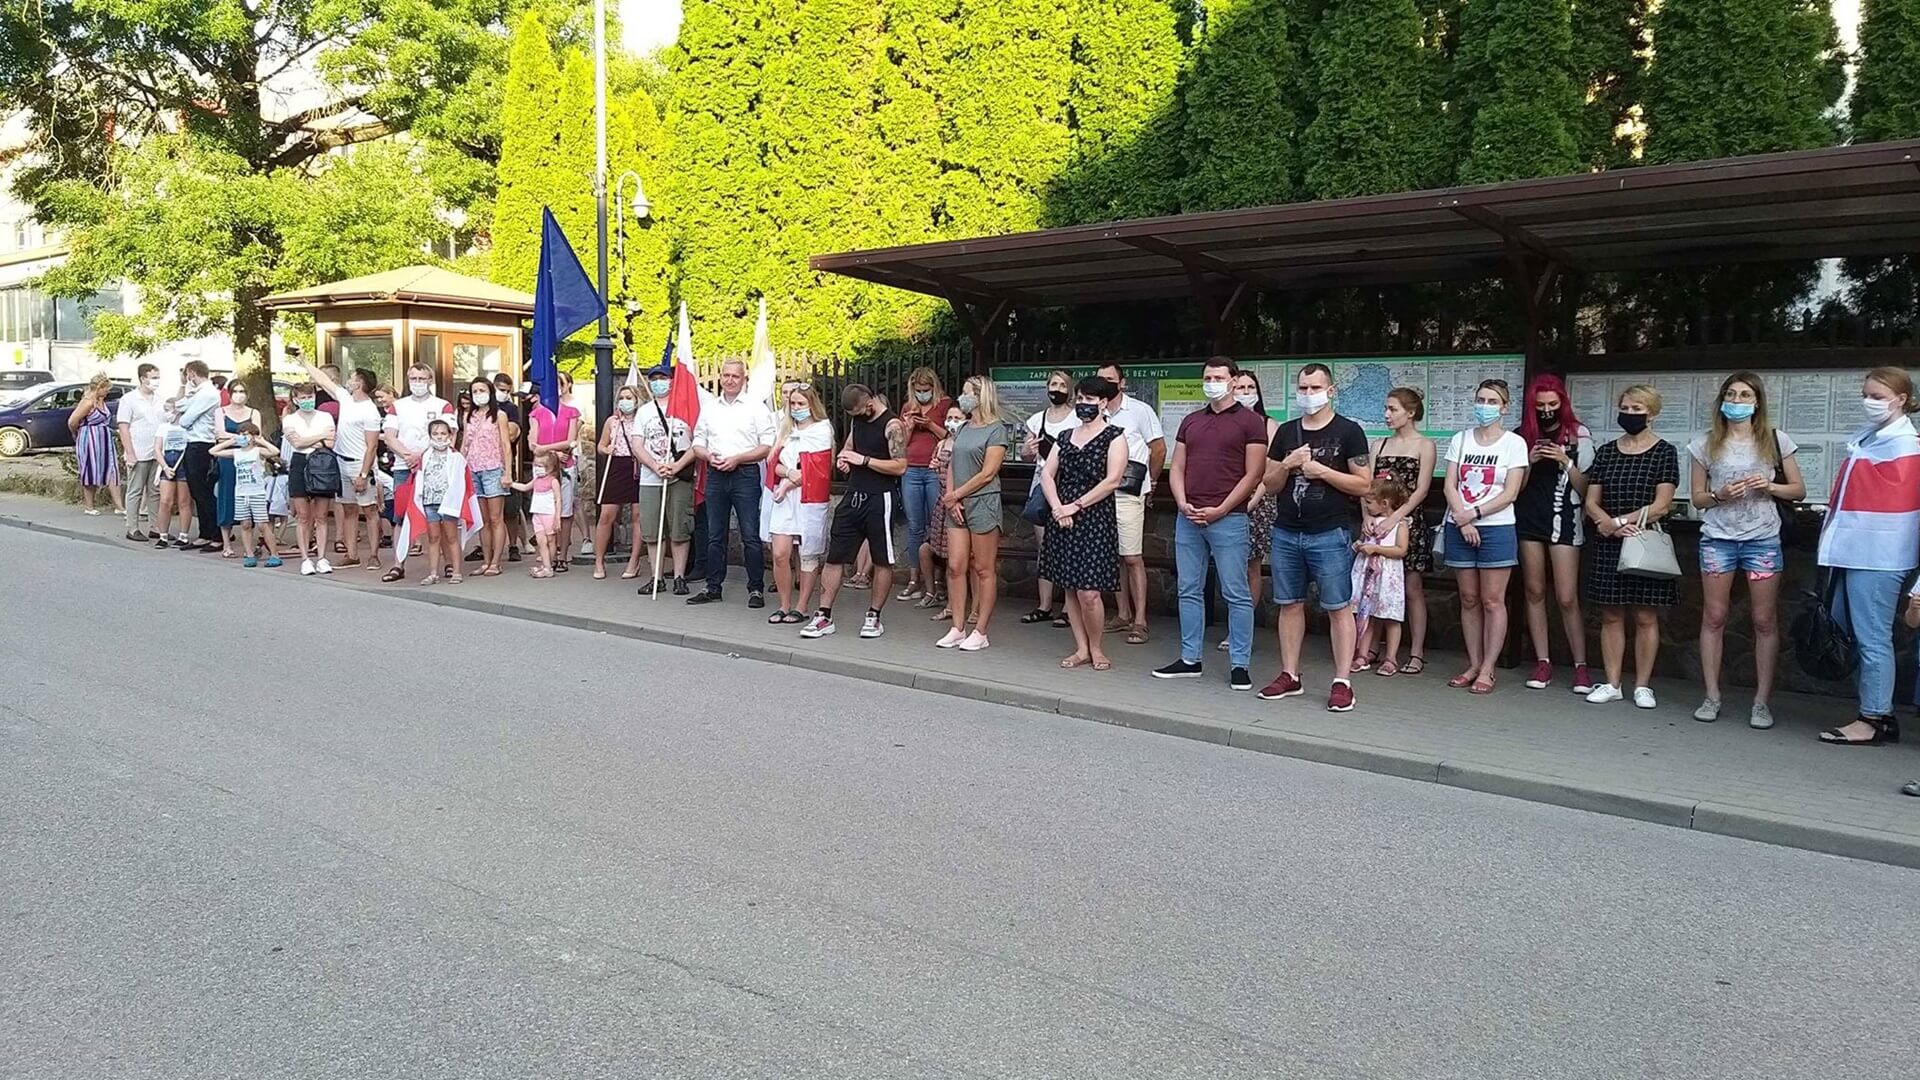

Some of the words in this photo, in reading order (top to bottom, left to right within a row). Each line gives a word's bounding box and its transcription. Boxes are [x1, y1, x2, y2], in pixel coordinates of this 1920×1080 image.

[1078, 370, 1089, 378] NA
[1133, 369, 1147, 378] BEZ
[1150, 368, 1169, 377] WIZY
[1463, 453, 1499, 465] WOLNI
